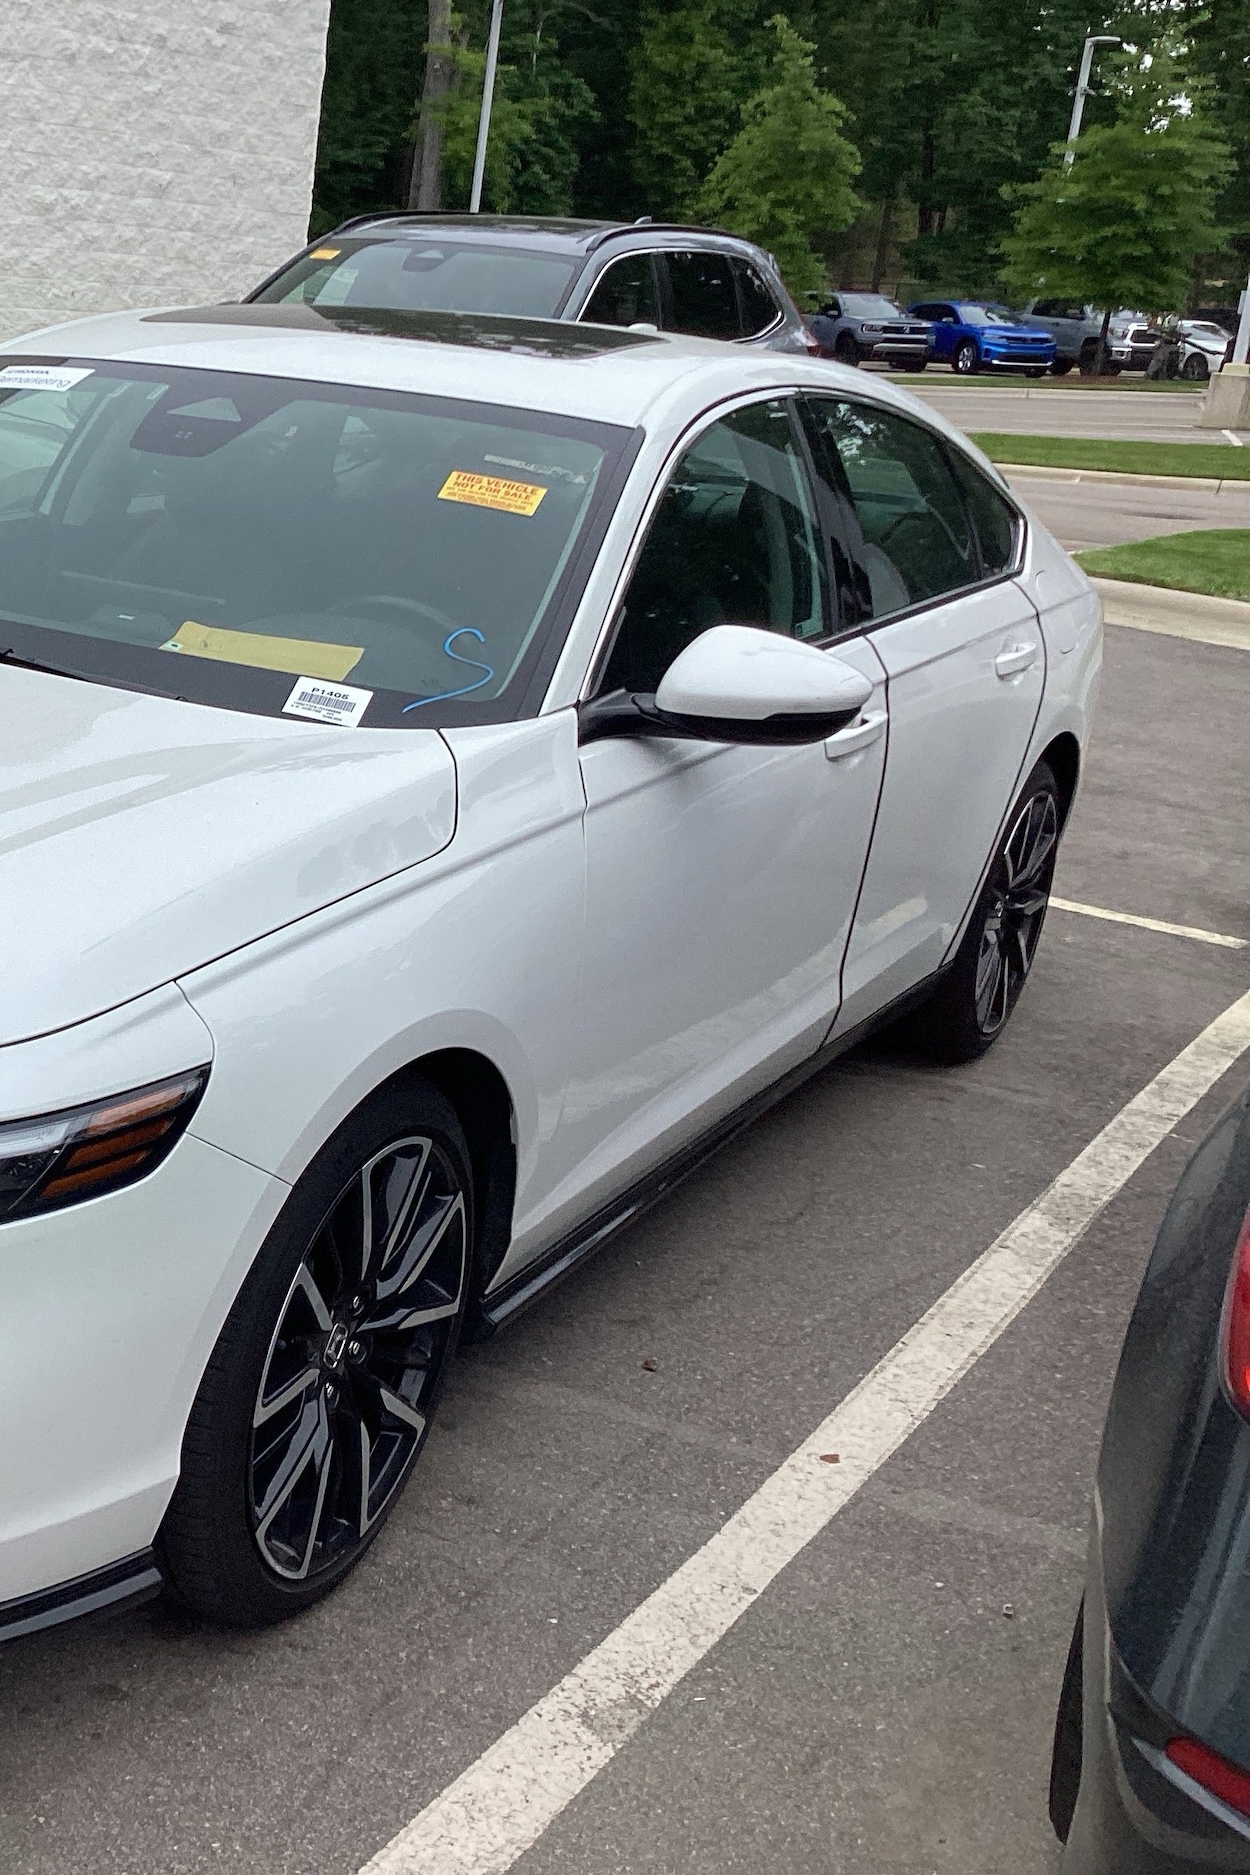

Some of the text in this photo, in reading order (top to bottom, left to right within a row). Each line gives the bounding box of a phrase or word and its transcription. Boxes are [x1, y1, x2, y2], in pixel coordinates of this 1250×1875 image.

[453, 481, 475, 491] NOT
[478, 485, 500, 494] FOR
[504, 490, 533, 500] SALE
[455, 473, 539, 495] THIS VEHICLE
